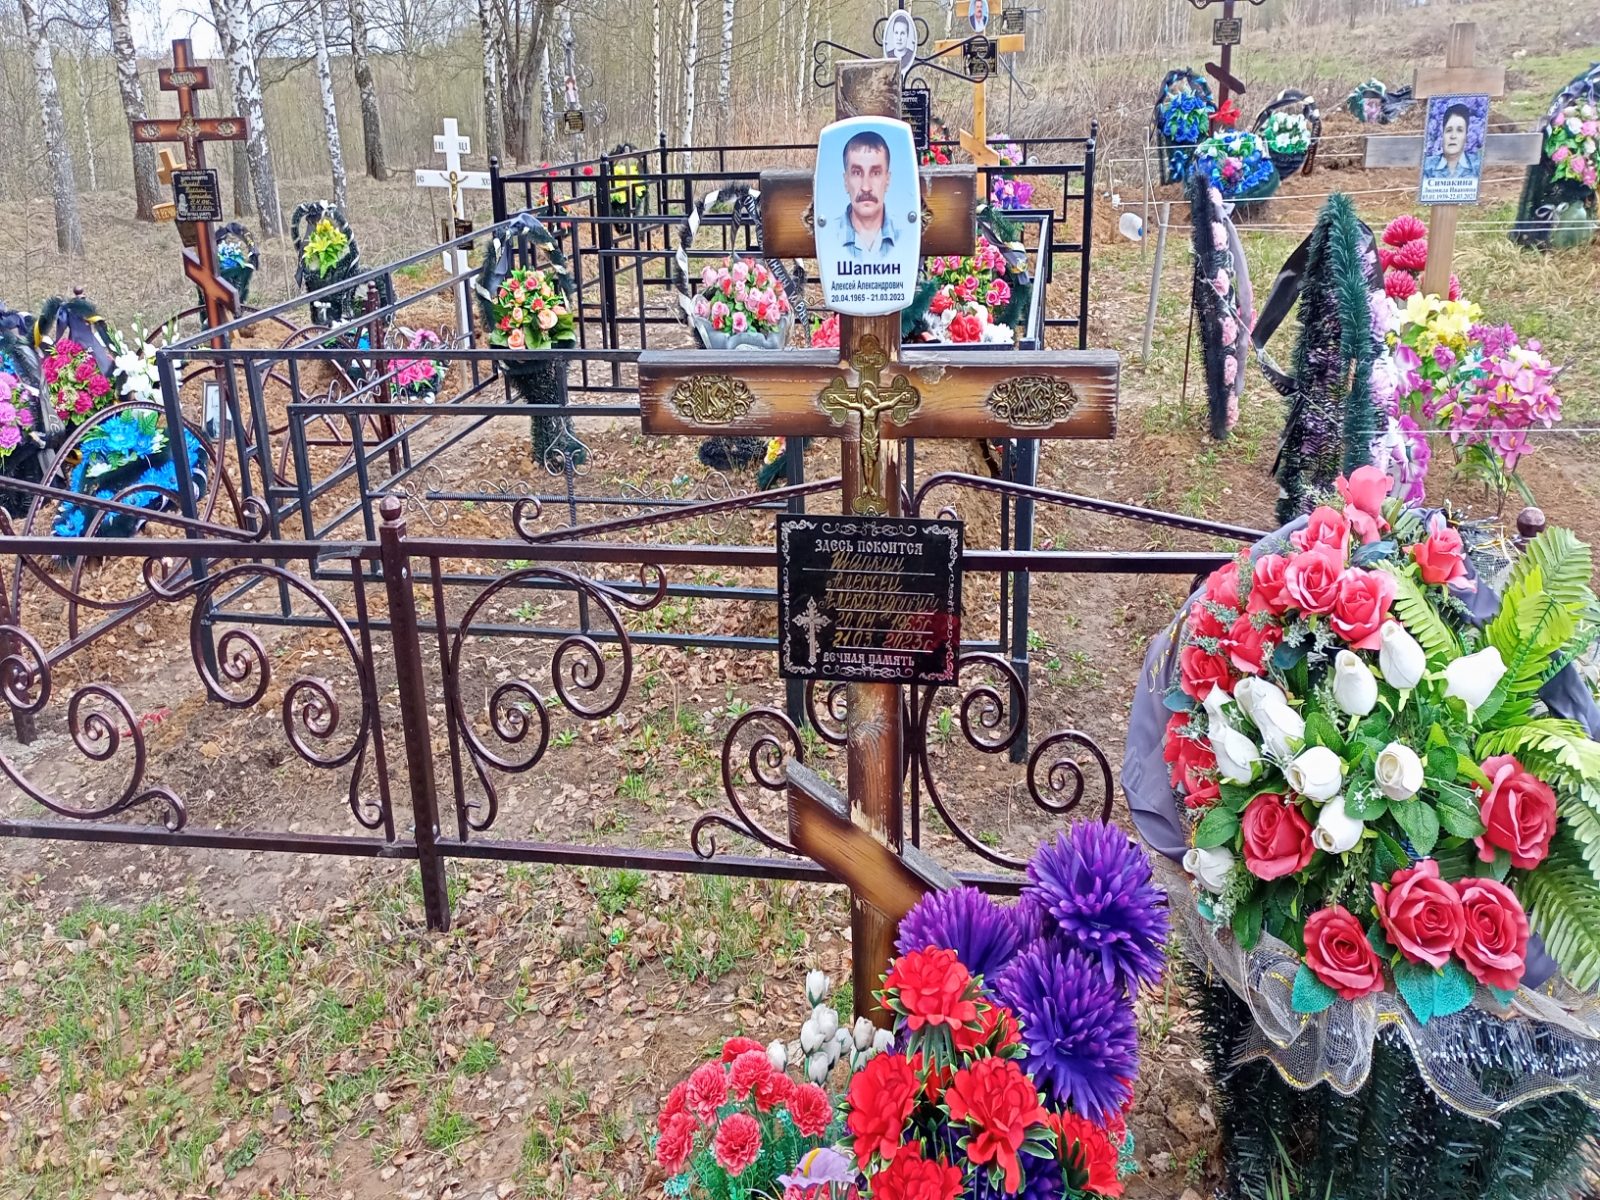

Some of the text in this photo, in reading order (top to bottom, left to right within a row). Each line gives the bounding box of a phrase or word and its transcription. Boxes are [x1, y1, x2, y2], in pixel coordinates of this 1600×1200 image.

[1427, 178, 1473, 187] Симакина
[837, 260, 901, 276] Шапкин
[831, 280, 904, 292] Алексей Александрович
[831, 294, 866, 303] 20.04.1965
[870, 293, 905, 302] 21.03.2023
[815, 539, 923, 555] ЗДЕСЬ ПОКОИТСЯ
[831, 551, 905, 573] Шапкин
[823, 652, 915, 667] ВЕЧНАЯ ПАМЯТЬ
